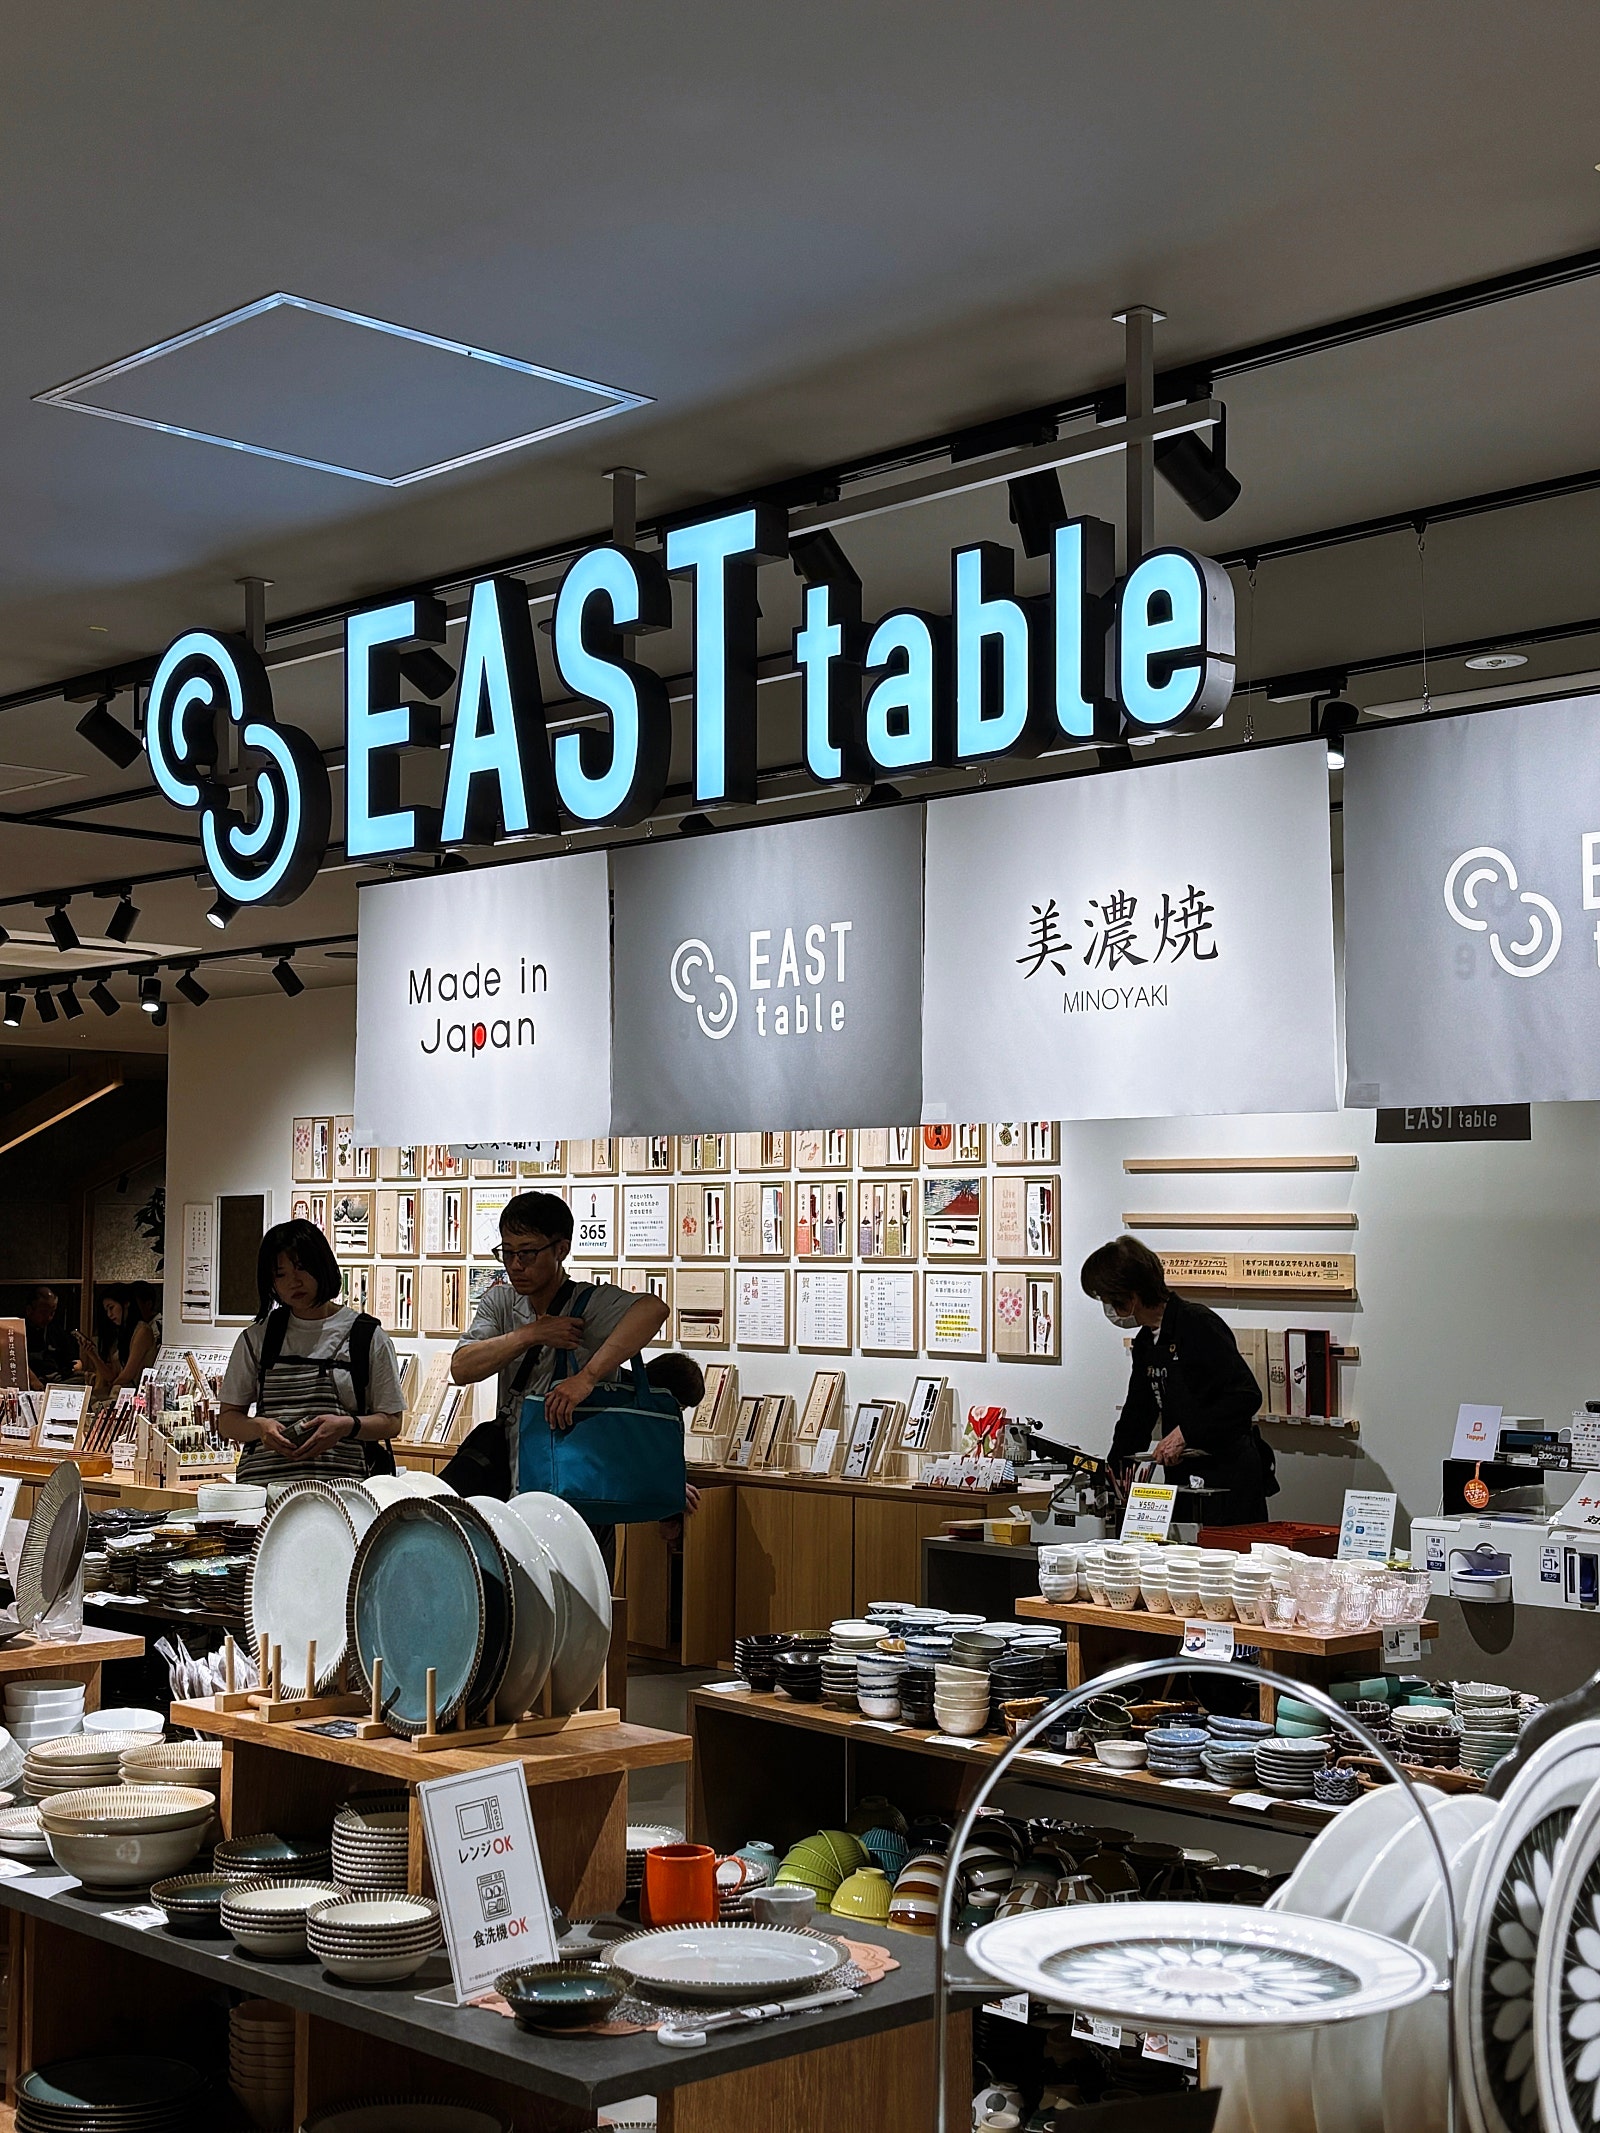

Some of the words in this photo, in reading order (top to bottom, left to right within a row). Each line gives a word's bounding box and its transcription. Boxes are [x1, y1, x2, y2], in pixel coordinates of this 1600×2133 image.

[346, 508, 757, 858] EAST
[795, 523, 1203, 780] table
[1015, 883, 1220, 981] 美濃焼
[749, 920, 853, 991] EAST
[408, 962, 502, 1006] Made
[519, 956, 549, 993] in
[1062, 984, 1169, 1015] MINOYAKI
[755, 992, 846, 1037] table
[419, 1015, 536, 1059] Japan
[1458, 1109, 1498, 1129] table
[578, 1240, 608, 1249] anniversary
[579, 1224, 607, 1241] 365
[458, 1834, 514, 1864] レンジOK
[472, 1915, 529, 1949] 食洗機OK
